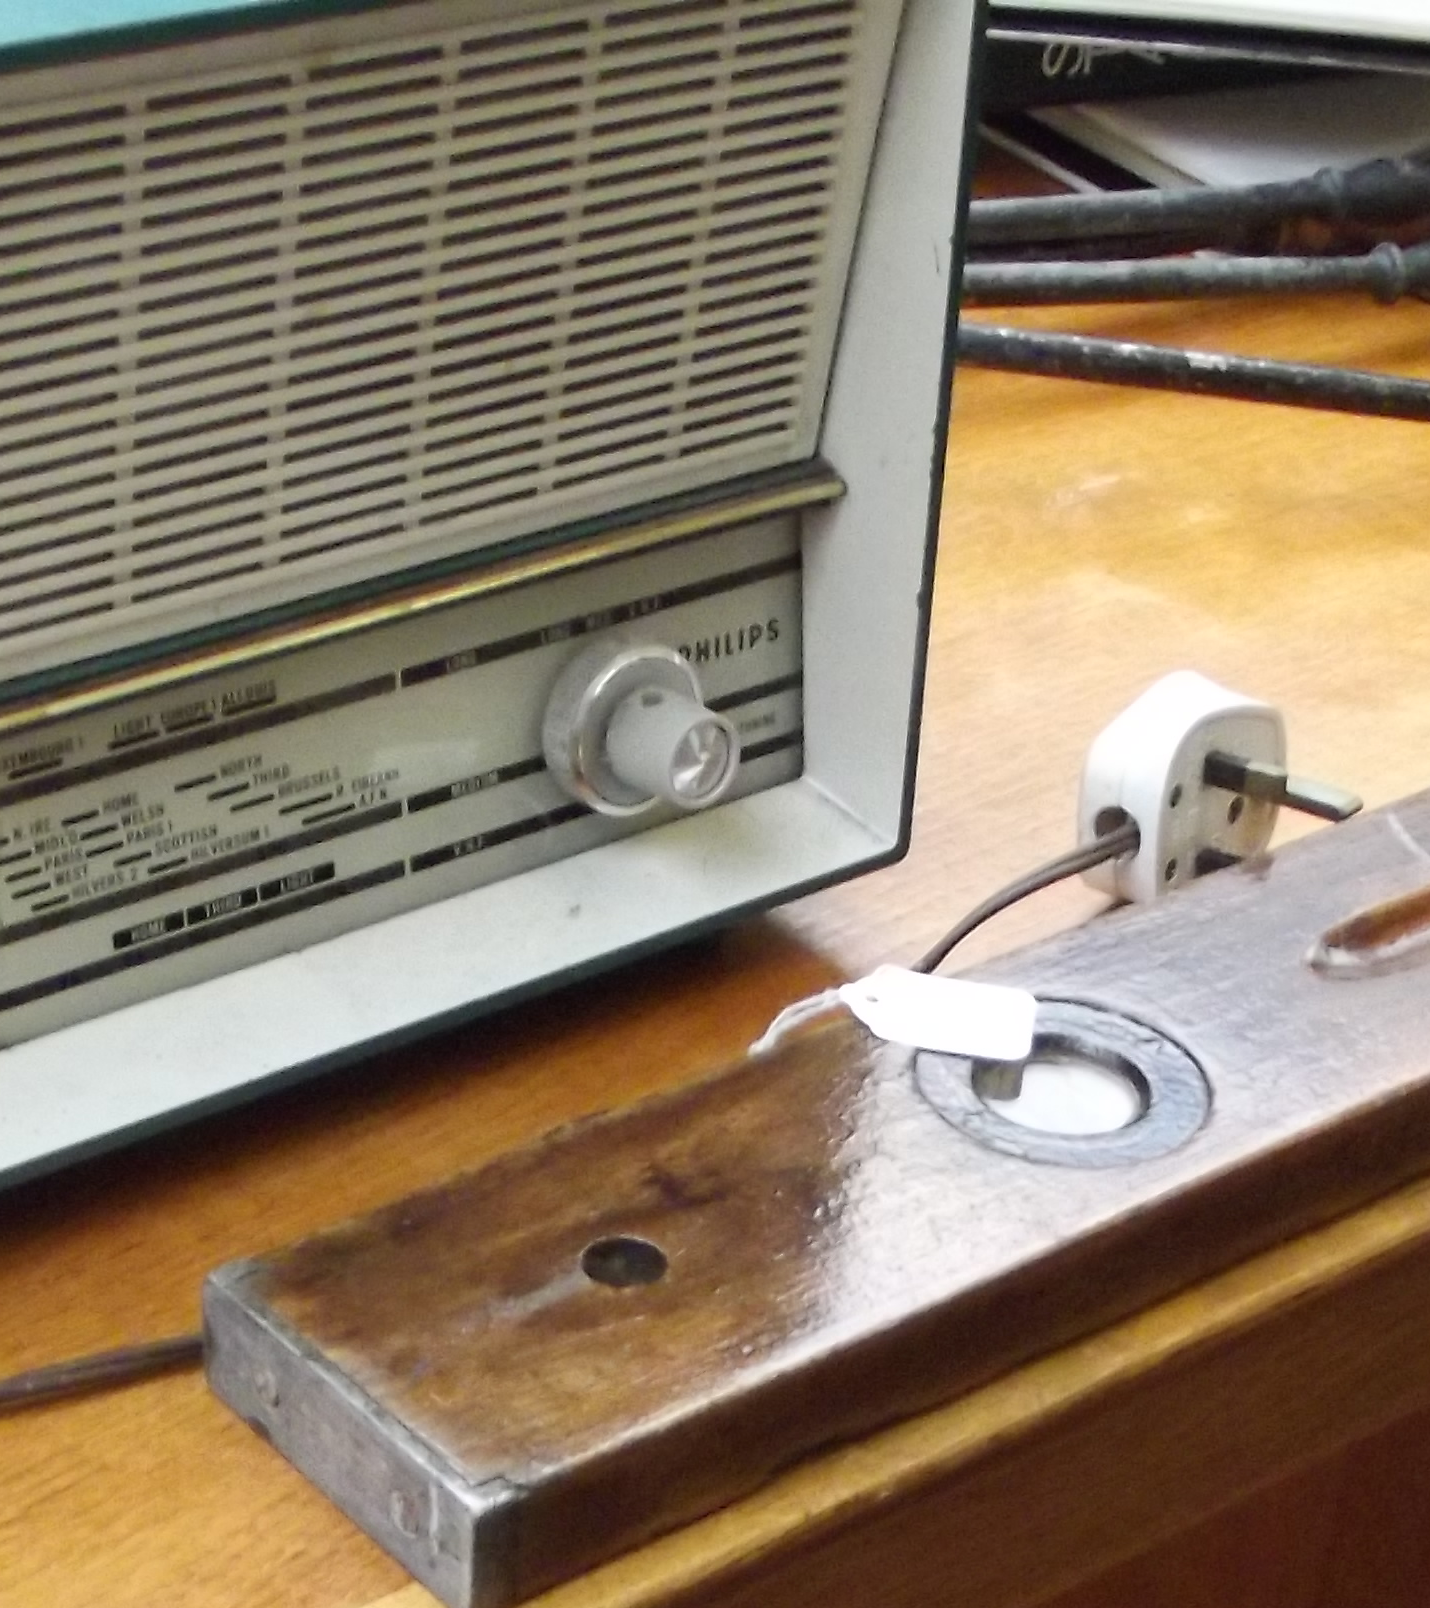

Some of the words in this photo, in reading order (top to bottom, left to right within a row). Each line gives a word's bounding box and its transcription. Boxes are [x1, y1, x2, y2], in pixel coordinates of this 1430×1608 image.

[678, 618, 780, 663] PHILIPS
[112, 714, 151, 739] LIGHT
[219, 754, 263, 778] NORTH
[252, 762, 290, 786] THIRD
[277, 765, 341, 797] BRUSSELS
[101, 792, 139, 814] HOME
[120, 803, 165, 827] WELSH
[154, 824, 218, 856] SCOTTISH
